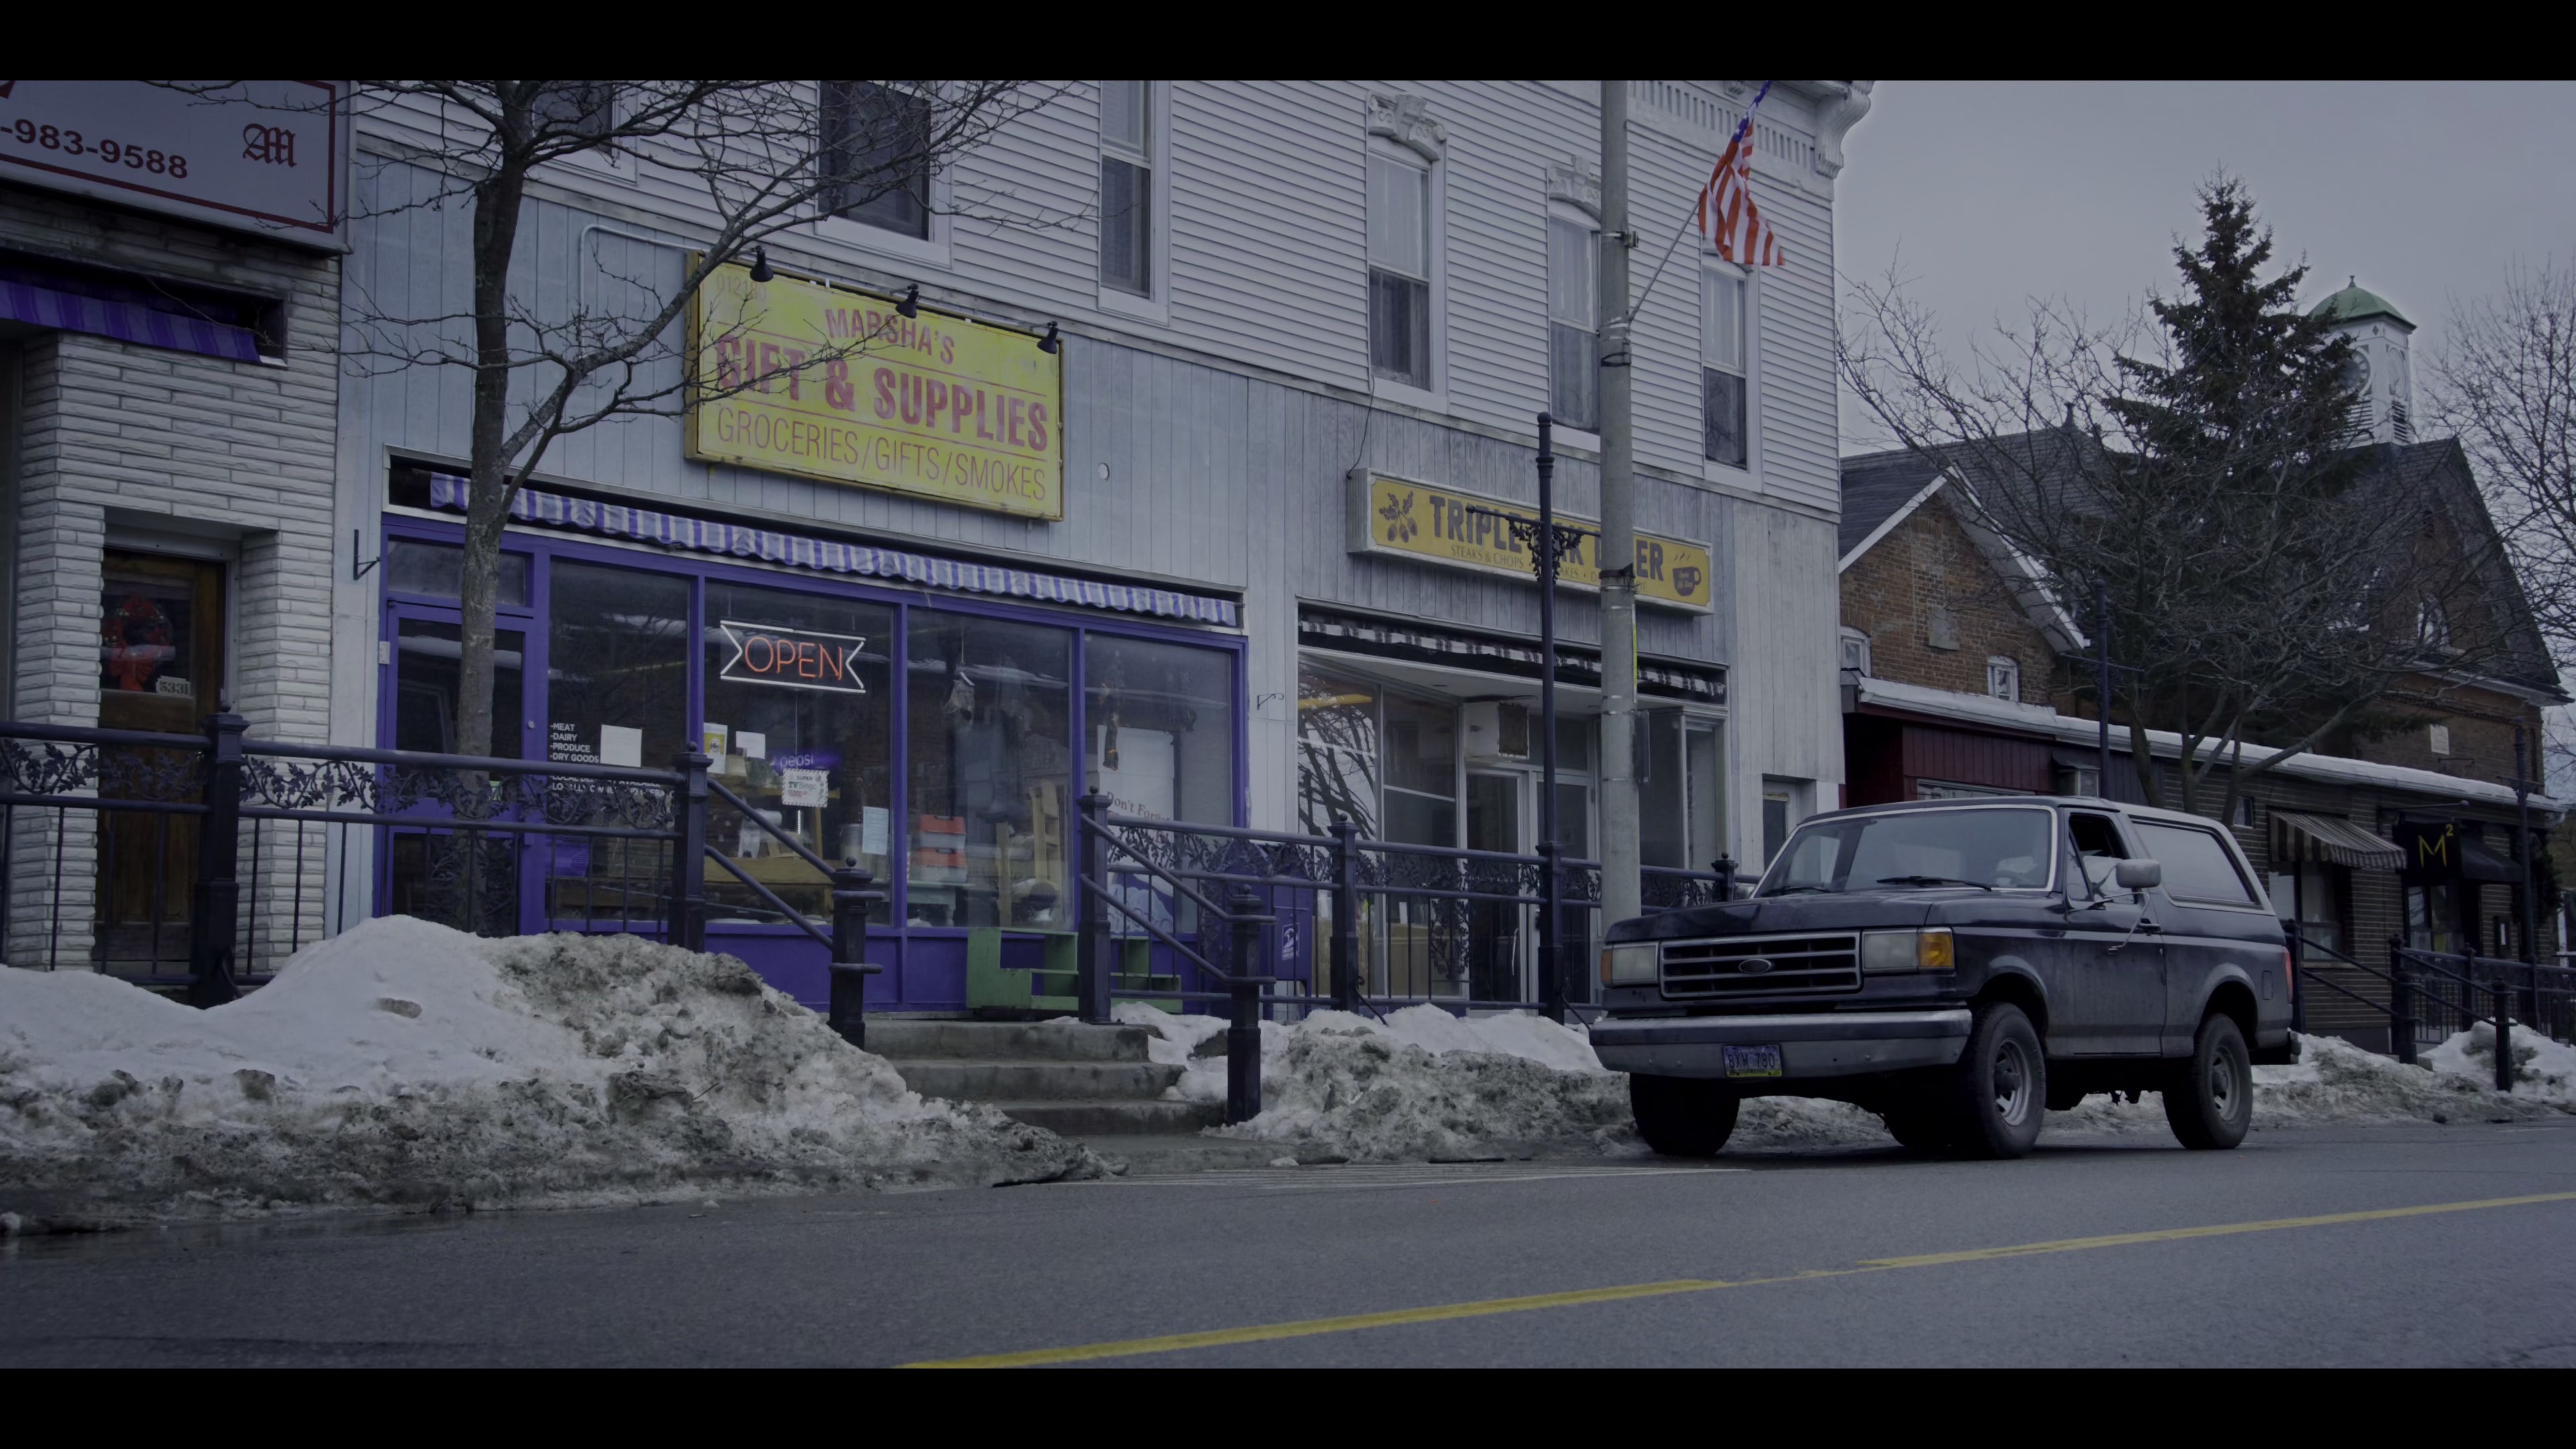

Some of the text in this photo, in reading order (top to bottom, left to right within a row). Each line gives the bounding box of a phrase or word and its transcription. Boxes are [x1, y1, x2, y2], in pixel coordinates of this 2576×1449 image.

[825, 308, 955, 365] MARSHA'S
[716, 333, 1048, 451] GIFT & SUPPLIES
[1429, 495, 1522, 553] TRIPLE
[1493, 552, 1523, 569] CHOPS
[745, 637, 843, 681] OPEN
[571, 753, 599, 763] GOODS
[1107, 792, 1134, 813] Don't
